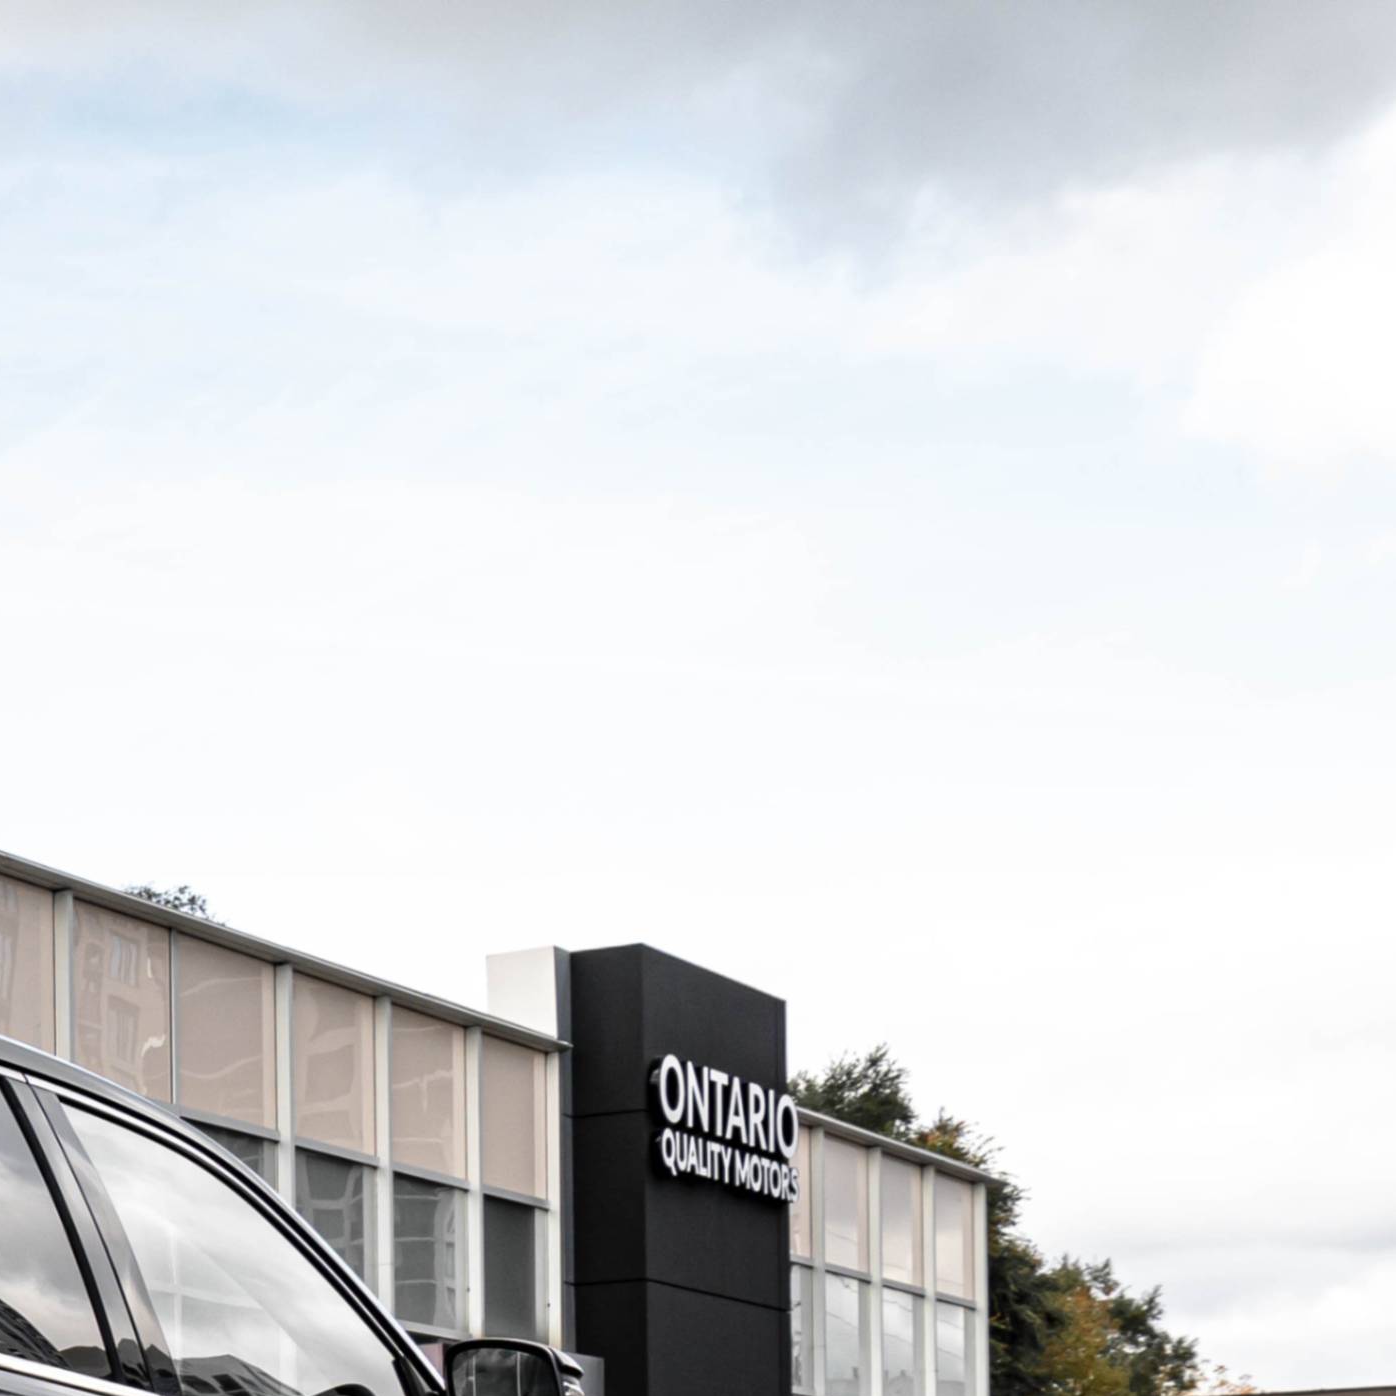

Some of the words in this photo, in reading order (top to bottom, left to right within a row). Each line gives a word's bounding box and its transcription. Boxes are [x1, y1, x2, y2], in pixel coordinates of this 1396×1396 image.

[660, 1054, 800, 1159] ONTARIO
[661, 1128, 732, 1184] QUALITY
[734, 1149, 800, 1202] MOTORS
